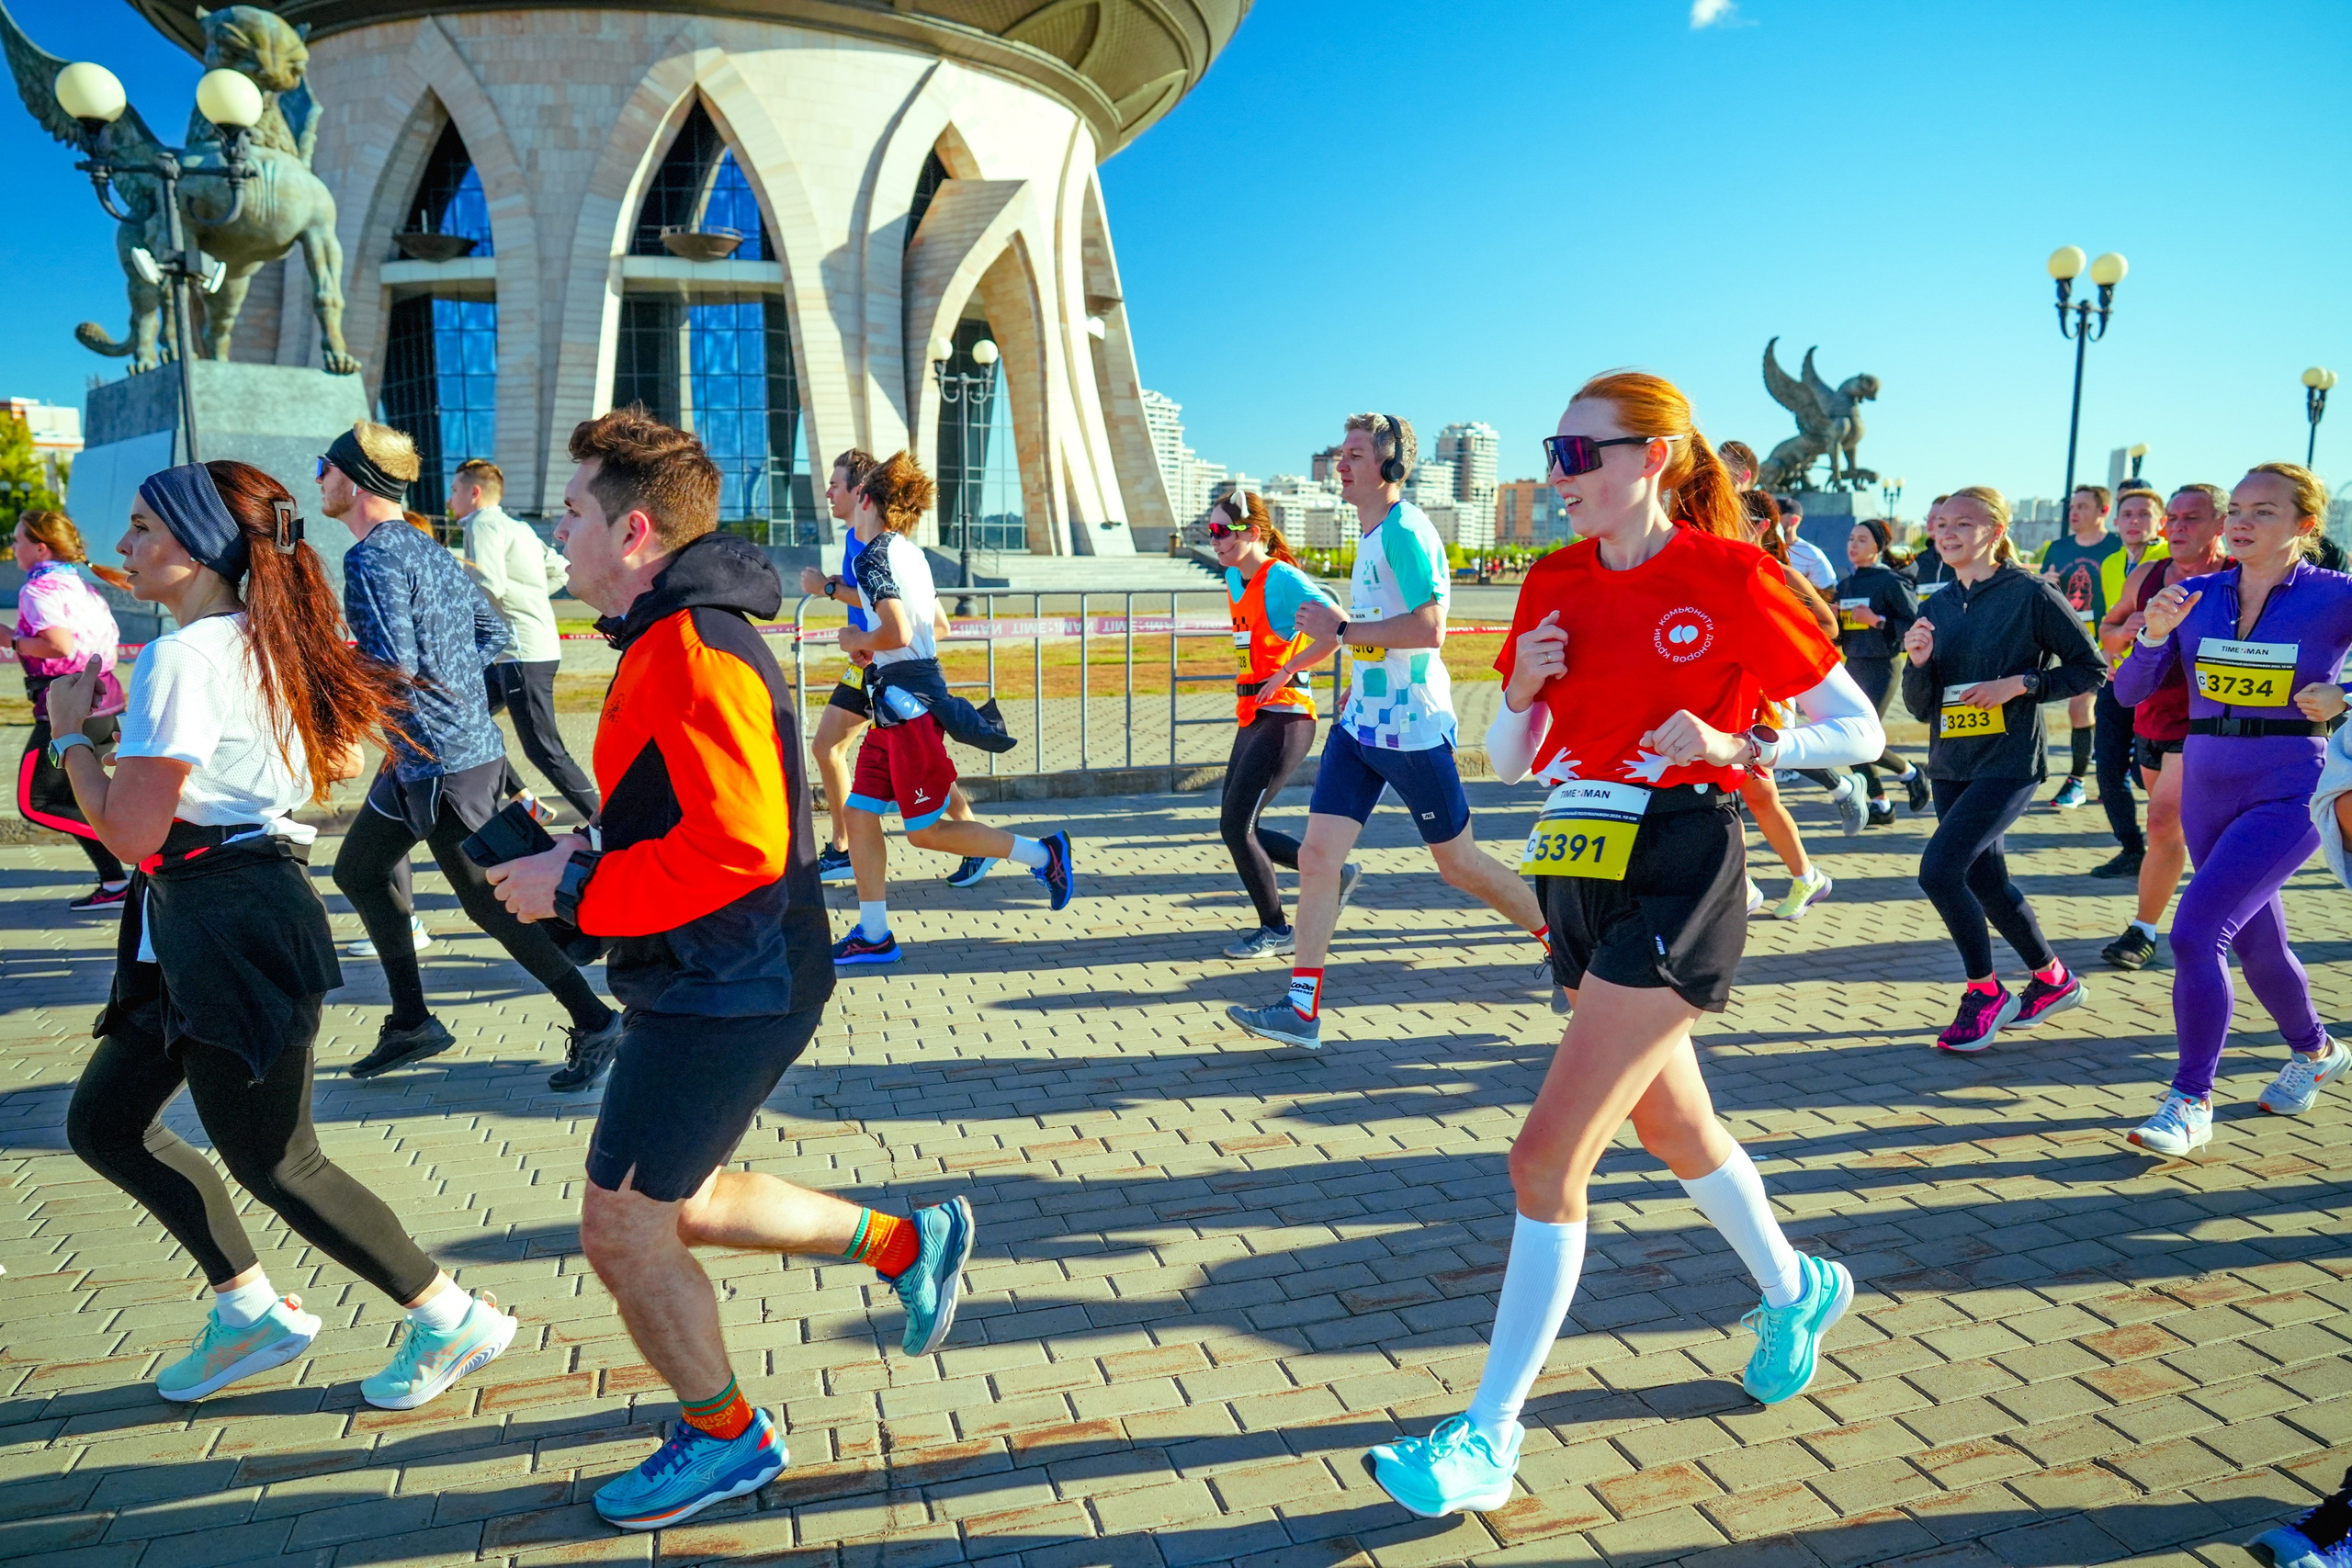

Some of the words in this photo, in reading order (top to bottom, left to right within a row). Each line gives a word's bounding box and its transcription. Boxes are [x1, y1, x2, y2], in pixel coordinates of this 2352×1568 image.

[2208, 674, 2273, 697] 3734
[1948, 712, 1990, 729] 3233
[1534, 833, 1606, 863] 5391
